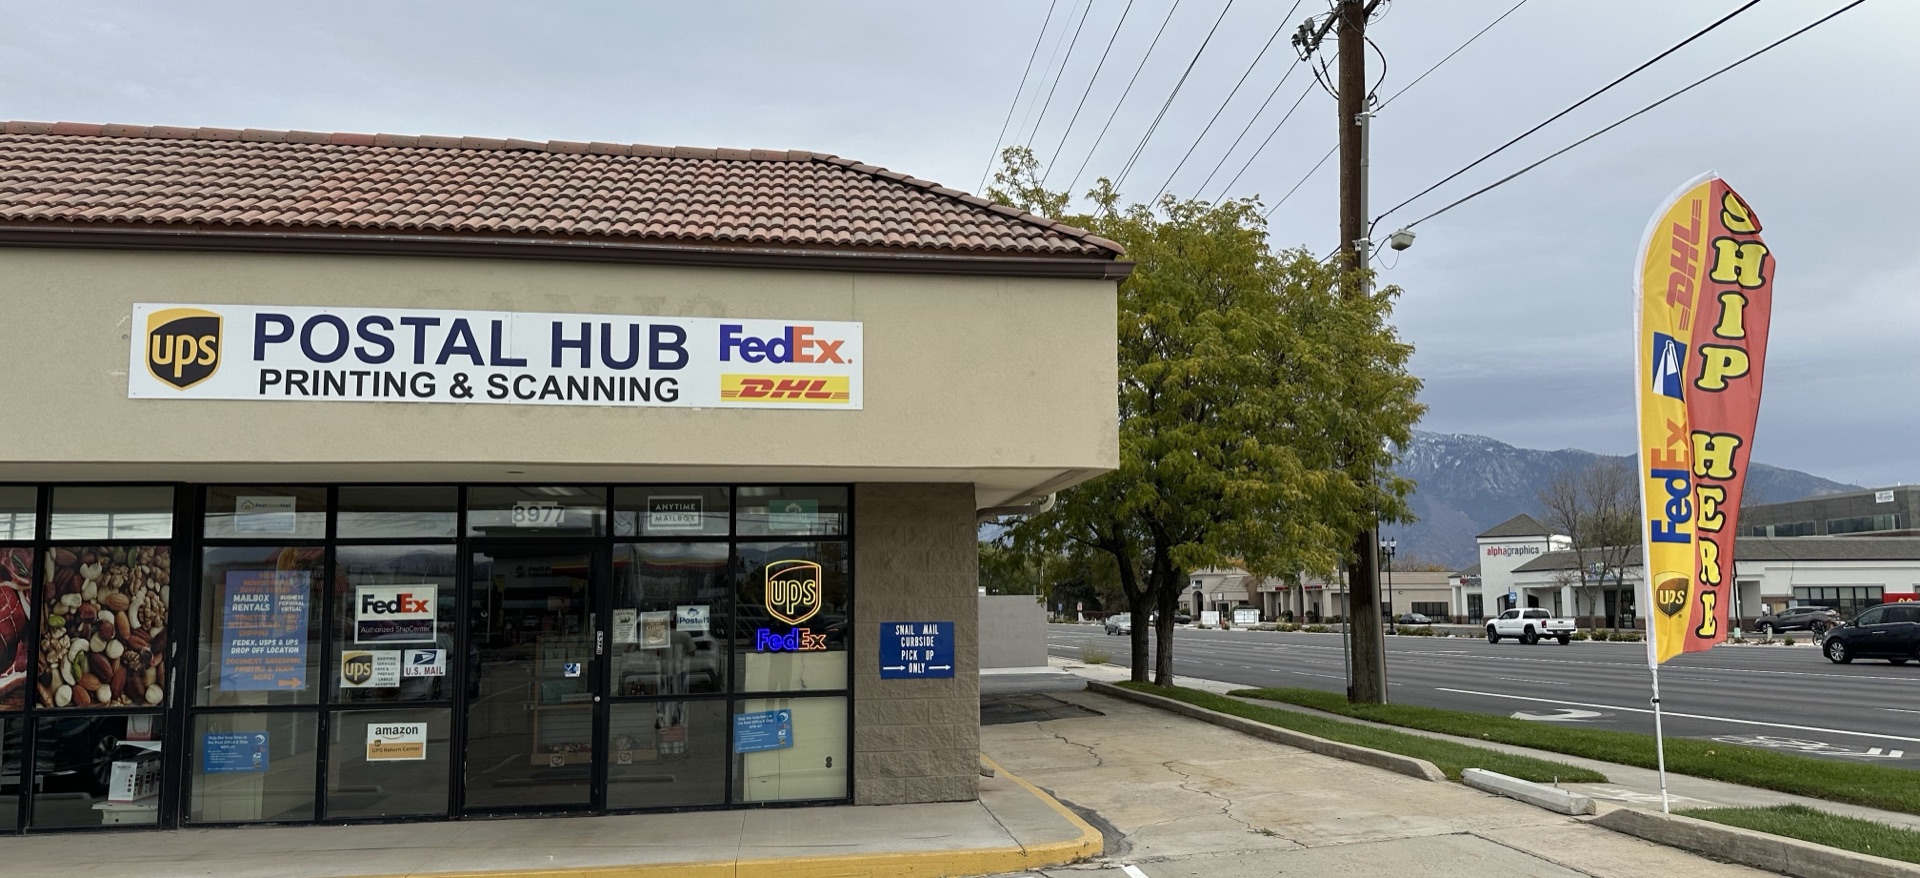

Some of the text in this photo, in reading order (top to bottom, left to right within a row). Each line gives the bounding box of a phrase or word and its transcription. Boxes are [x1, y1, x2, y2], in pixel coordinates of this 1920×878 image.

[1665, 219, 1701, 312] DHL
[1694, 190, 1769, 392] SHIP
[253, 313, 690, 370] POSTAL HUB
[151, 333, 217, 378] ups
[259, 368, 679, 402] PRINTING & SCANNING
[738, 378, 832, 399] DHL
[1651, 418, 1692, 544] FedEx
[513, 506, 564, 523] 8977
[655, 503, 696, 511] ANYTIME
[654, 515, 696, 523] MAILBOX
[1691, 430, 1743, 638] HERE
[1487, 545, 1540, 557] alphagraphics
[233, 594, 269, 602] MAILBOX
[362, 593, 429, 614] FedEx
[771, 579, 816, 615] ups
[232, 603, 270, 611] RENTALS
[895, 624, 939, 635] SNAIL MAIL
[758, 627, 827, 650] FedEx
[901, 636, 934, 647] CURBSIDE
[901, 650, 934, 660] PICK UP
[406, 667, 422, 675] U.S.
[424, 666, 443, 675] MAIL
[908, 662, 925, 673] ONLY
[375, 726, 419, 736] amazon
